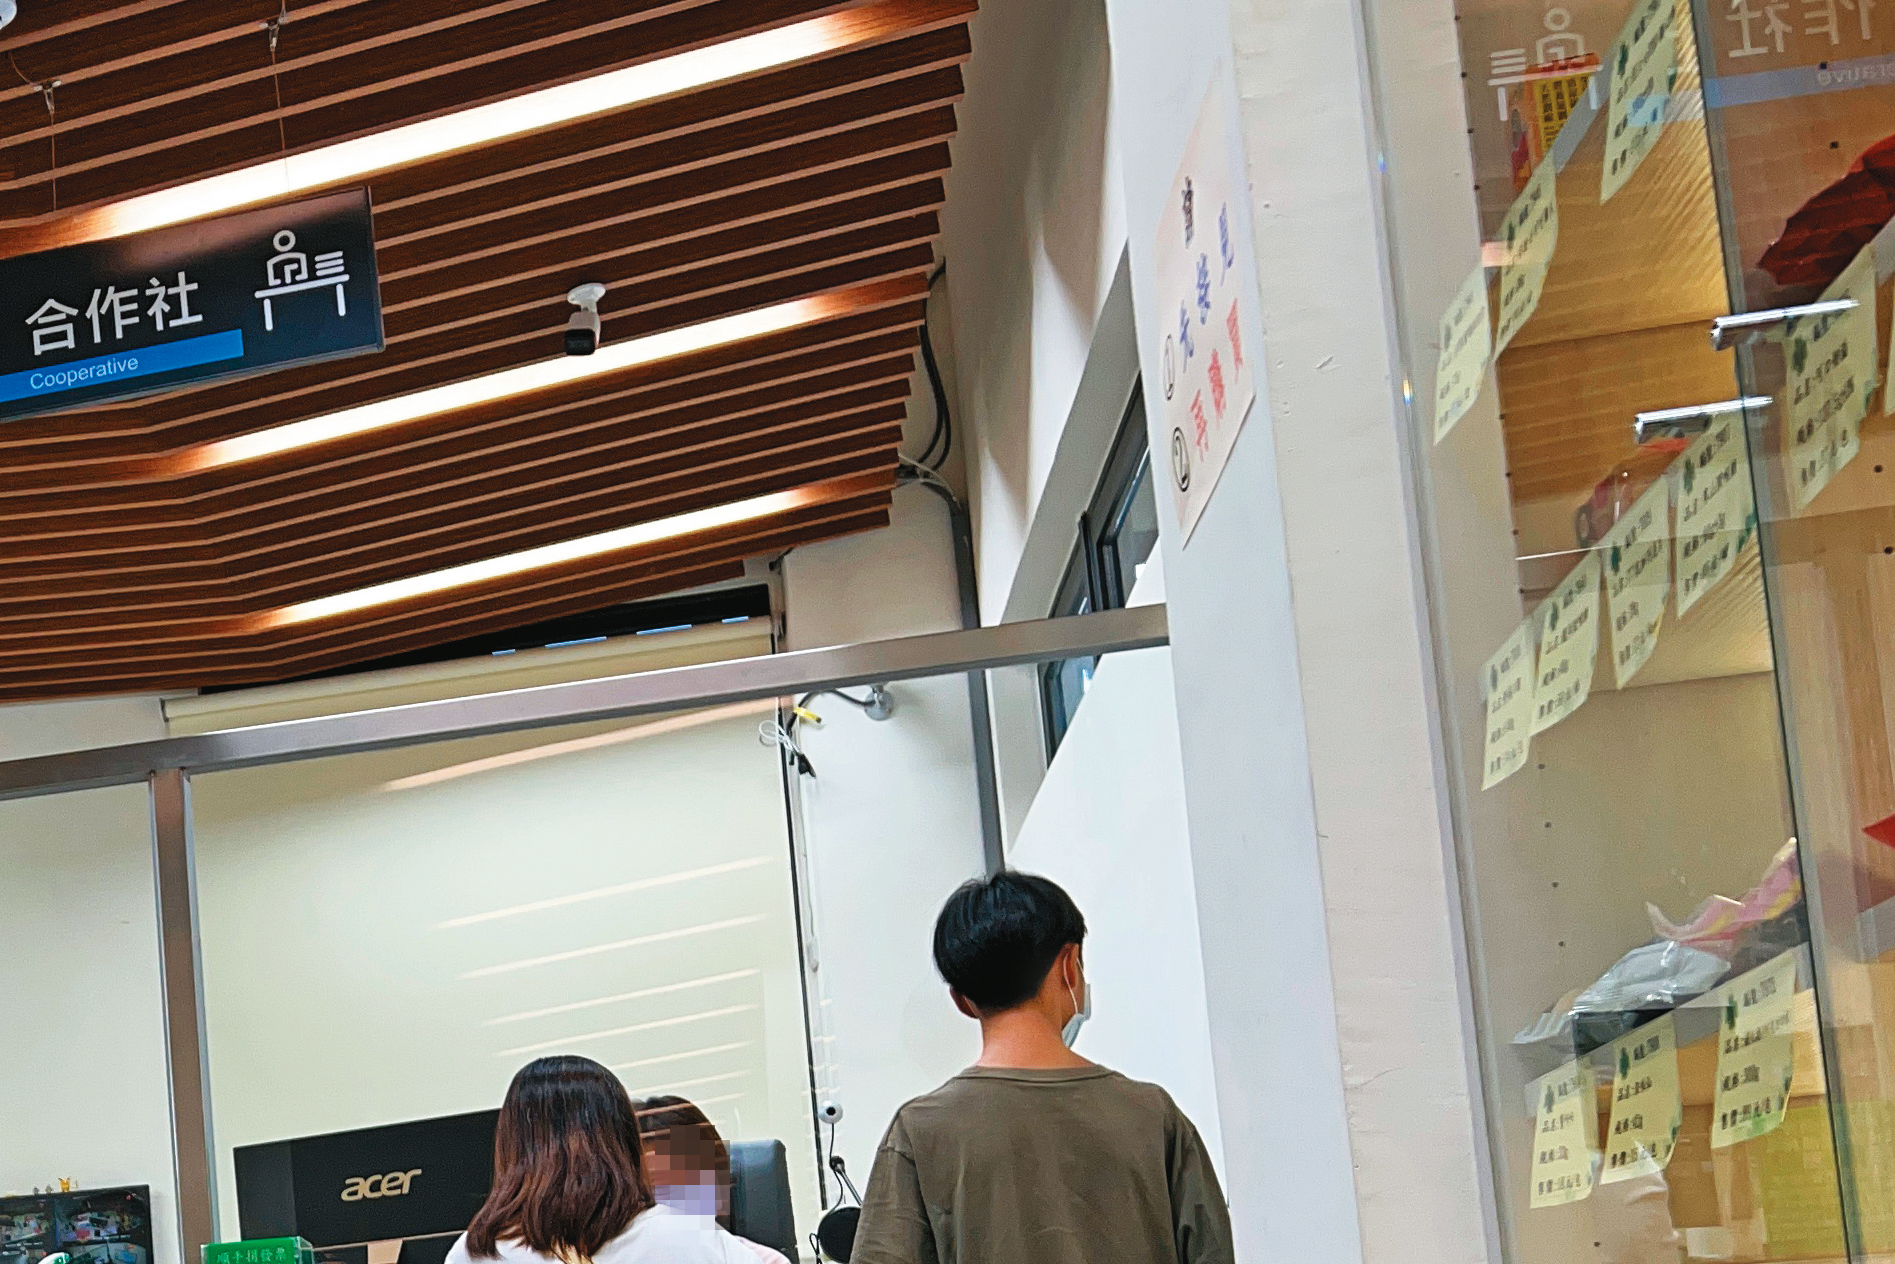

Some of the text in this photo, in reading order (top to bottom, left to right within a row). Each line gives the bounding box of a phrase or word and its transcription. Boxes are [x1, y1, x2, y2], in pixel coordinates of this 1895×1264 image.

[25, 271, 203, 355] 合作社
[30, 355, 139, 389] Cooperative
[341, 1168, 423, 1201] acer
